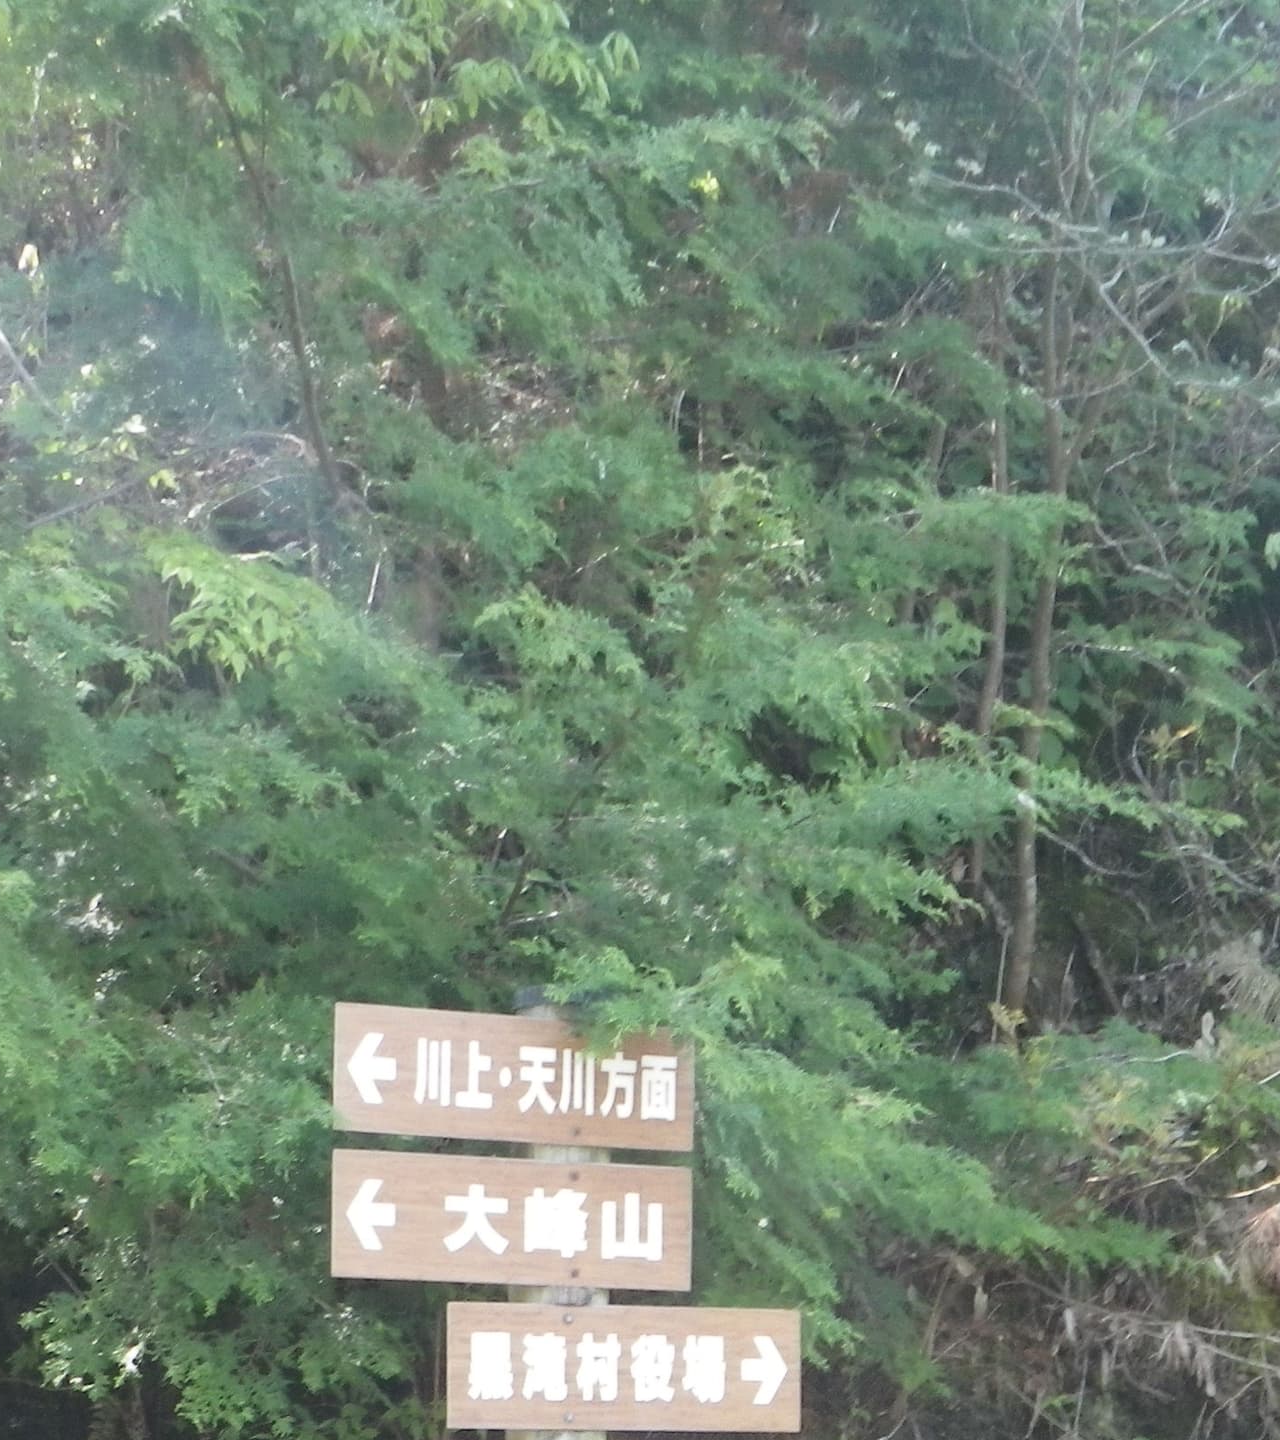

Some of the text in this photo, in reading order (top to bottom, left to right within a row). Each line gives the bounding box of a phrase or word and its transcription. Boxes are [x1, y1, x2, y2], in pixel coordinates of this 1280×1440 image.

[414, 1038, 678, 1121] 川上・天川方面
[443, 1184, 664, 1261] 大峰山
[468, 1332, 726, 1402] 黒滝村役場
